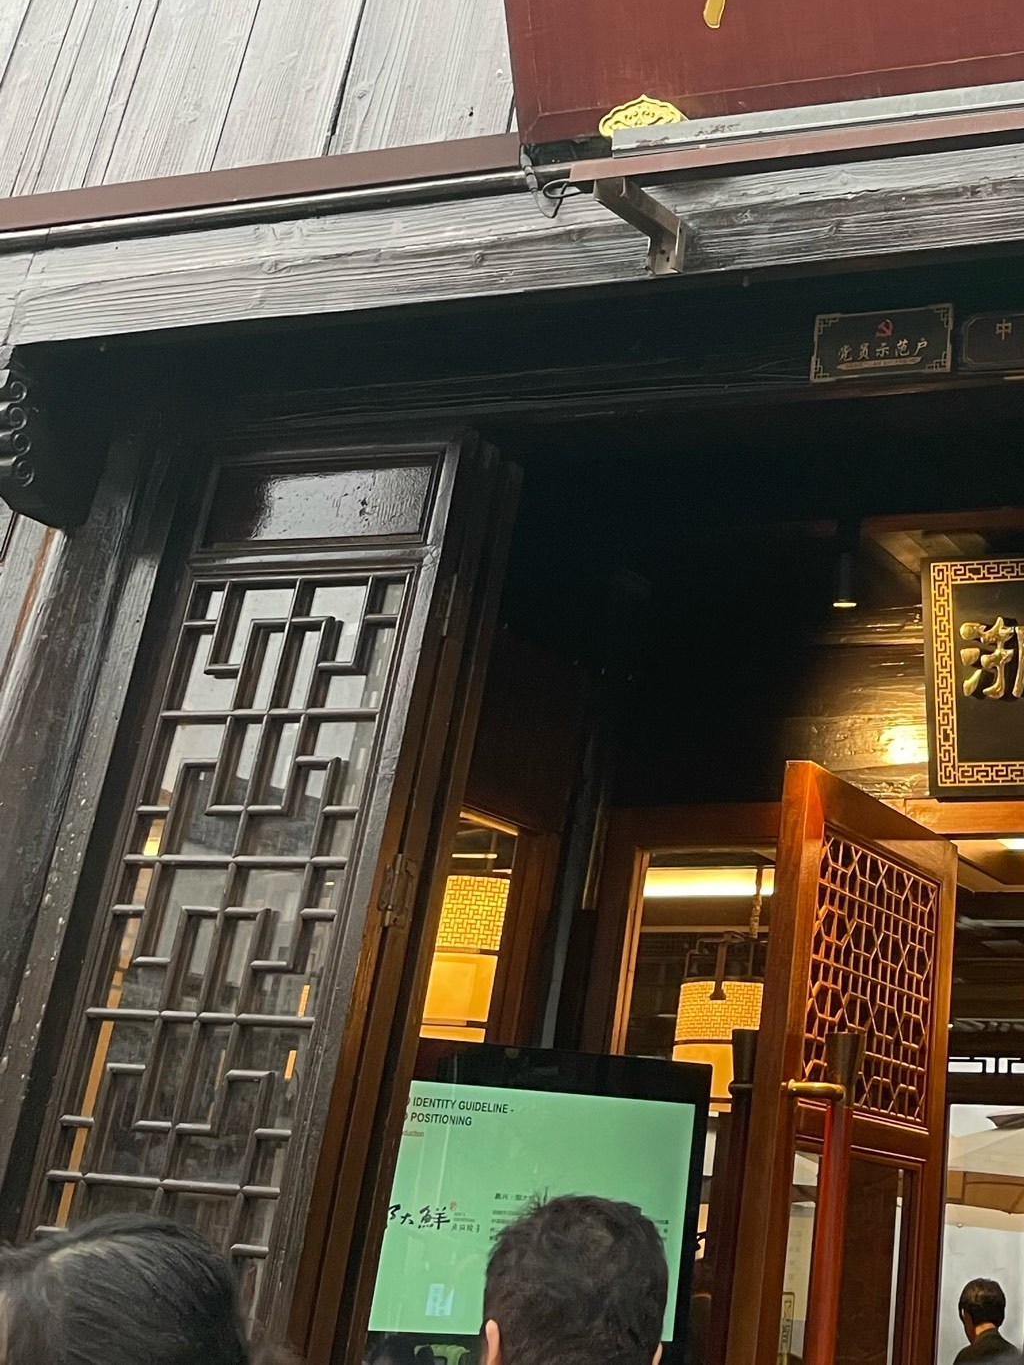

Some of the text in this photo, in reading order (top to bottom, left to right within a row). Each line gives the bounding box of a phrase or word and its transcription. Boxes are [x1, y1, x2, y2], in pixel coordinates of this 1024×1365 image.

[838, 338, 929, 362] 党员示范户
[412, 1096, 457, 1110] IDENTITY
[458, 1100, 509, 1114] GUIDELINE
[410, 1112, 472, 1126] POSITIONING
